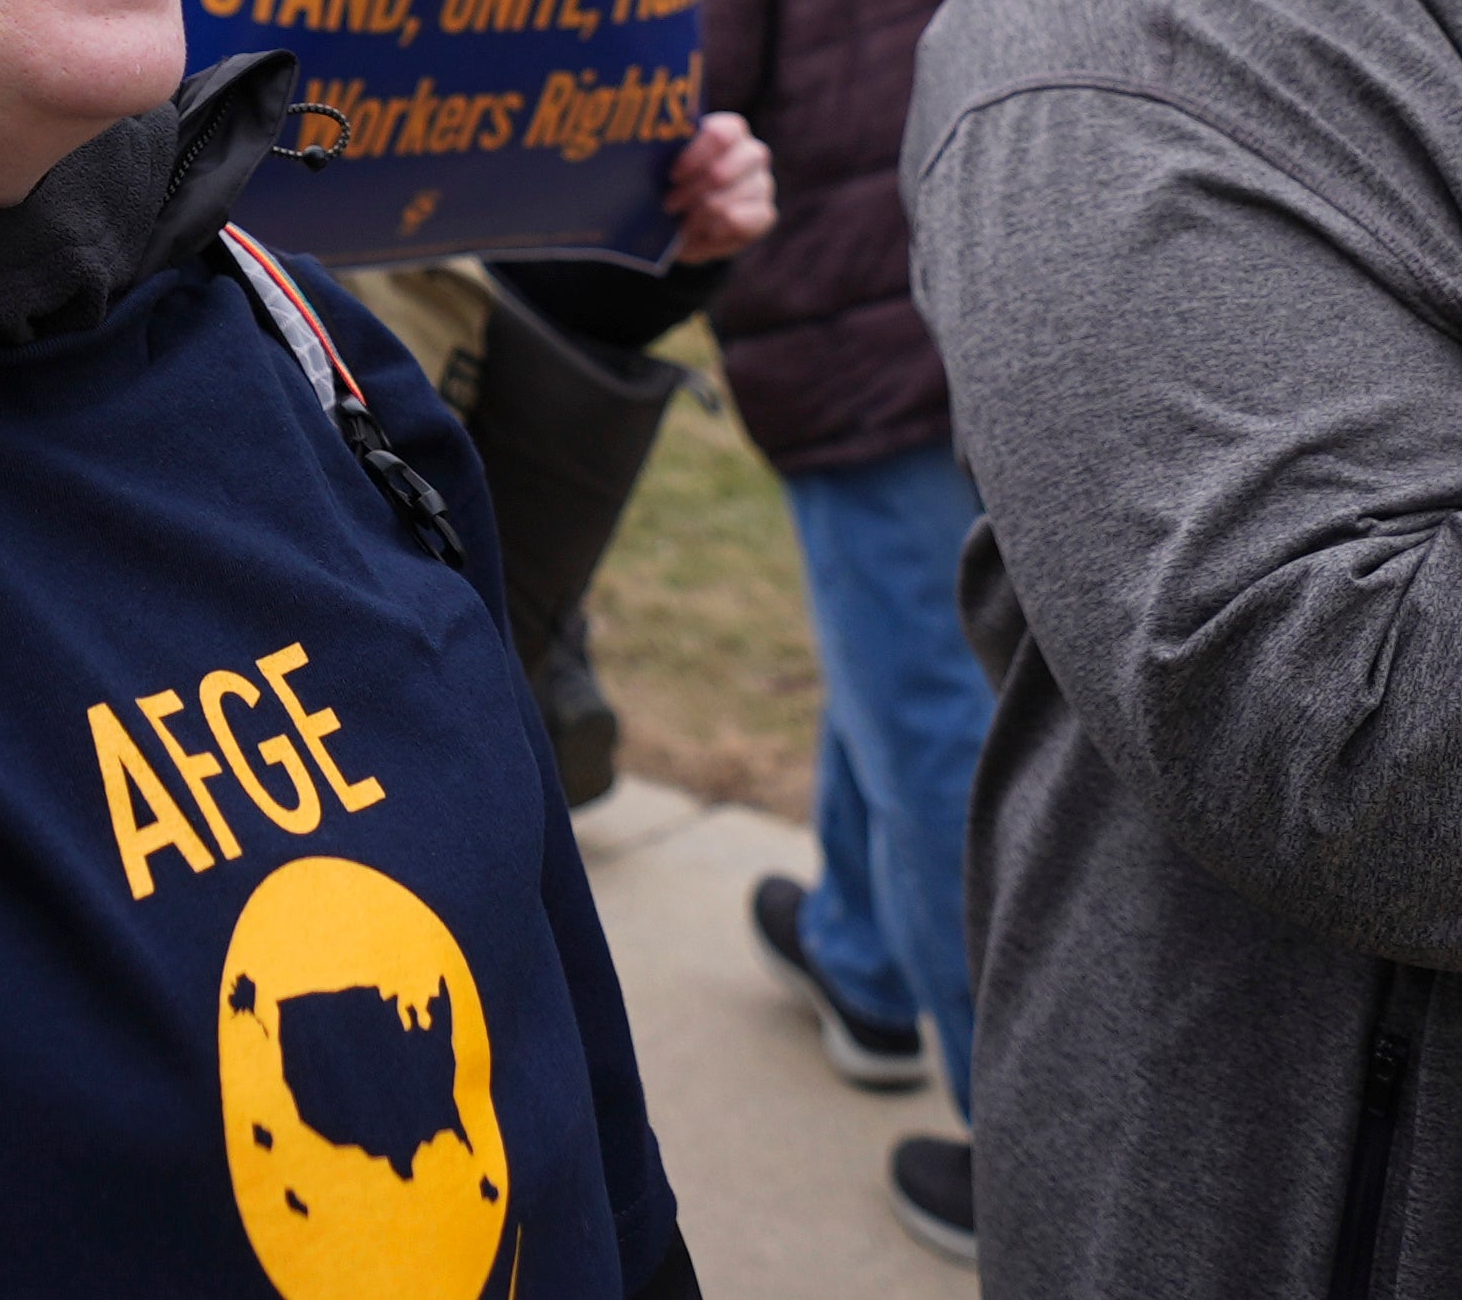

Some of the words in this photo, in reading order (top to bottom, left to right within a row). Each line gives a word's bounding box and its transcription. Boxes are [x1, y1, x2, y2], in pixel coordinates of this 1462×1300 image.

[296, 76, 525, 162] Workers
[524, 51, 704, 162] Rights!
[87, 641, 385, 899] AFGE
